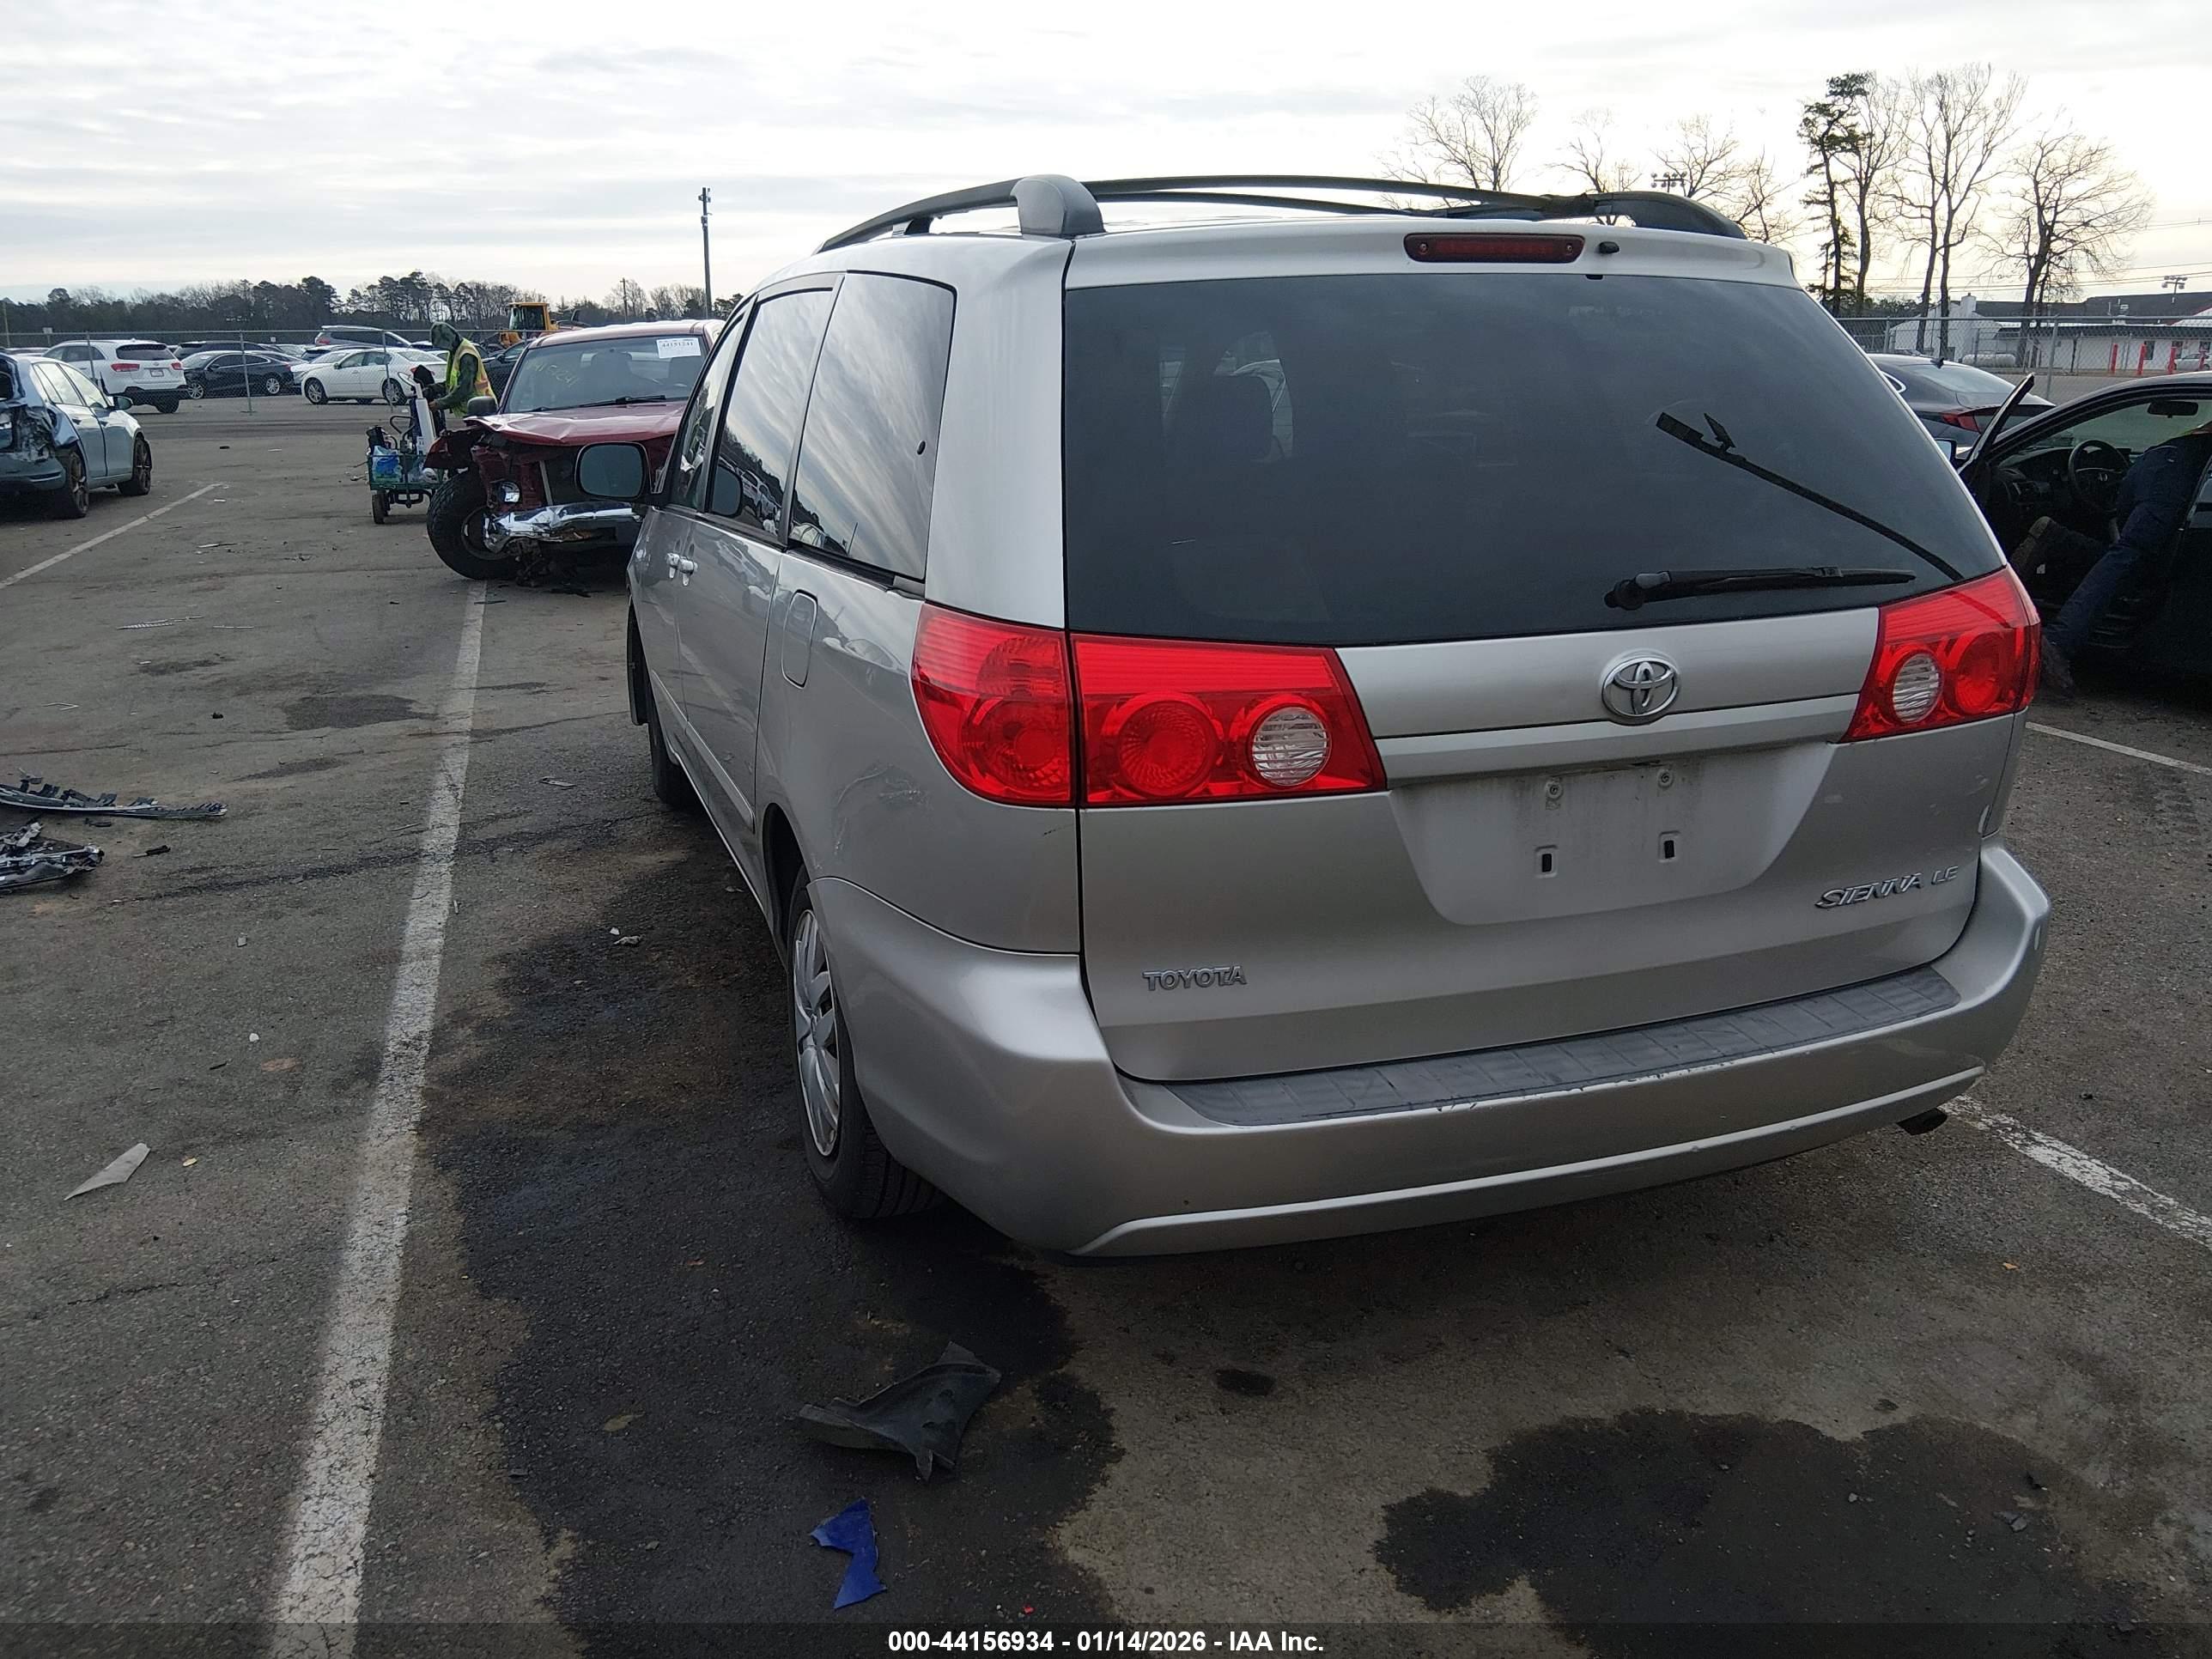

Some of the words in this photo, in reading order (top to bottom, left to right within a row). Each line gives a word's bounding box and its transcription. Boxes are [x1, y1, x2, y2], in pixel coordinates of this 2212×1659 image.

[1814, 872, 1923, 908] SIENNA
[1931, 866, 1959, 884] LE
[1142, 965, 1247, 991] TOYOTA
